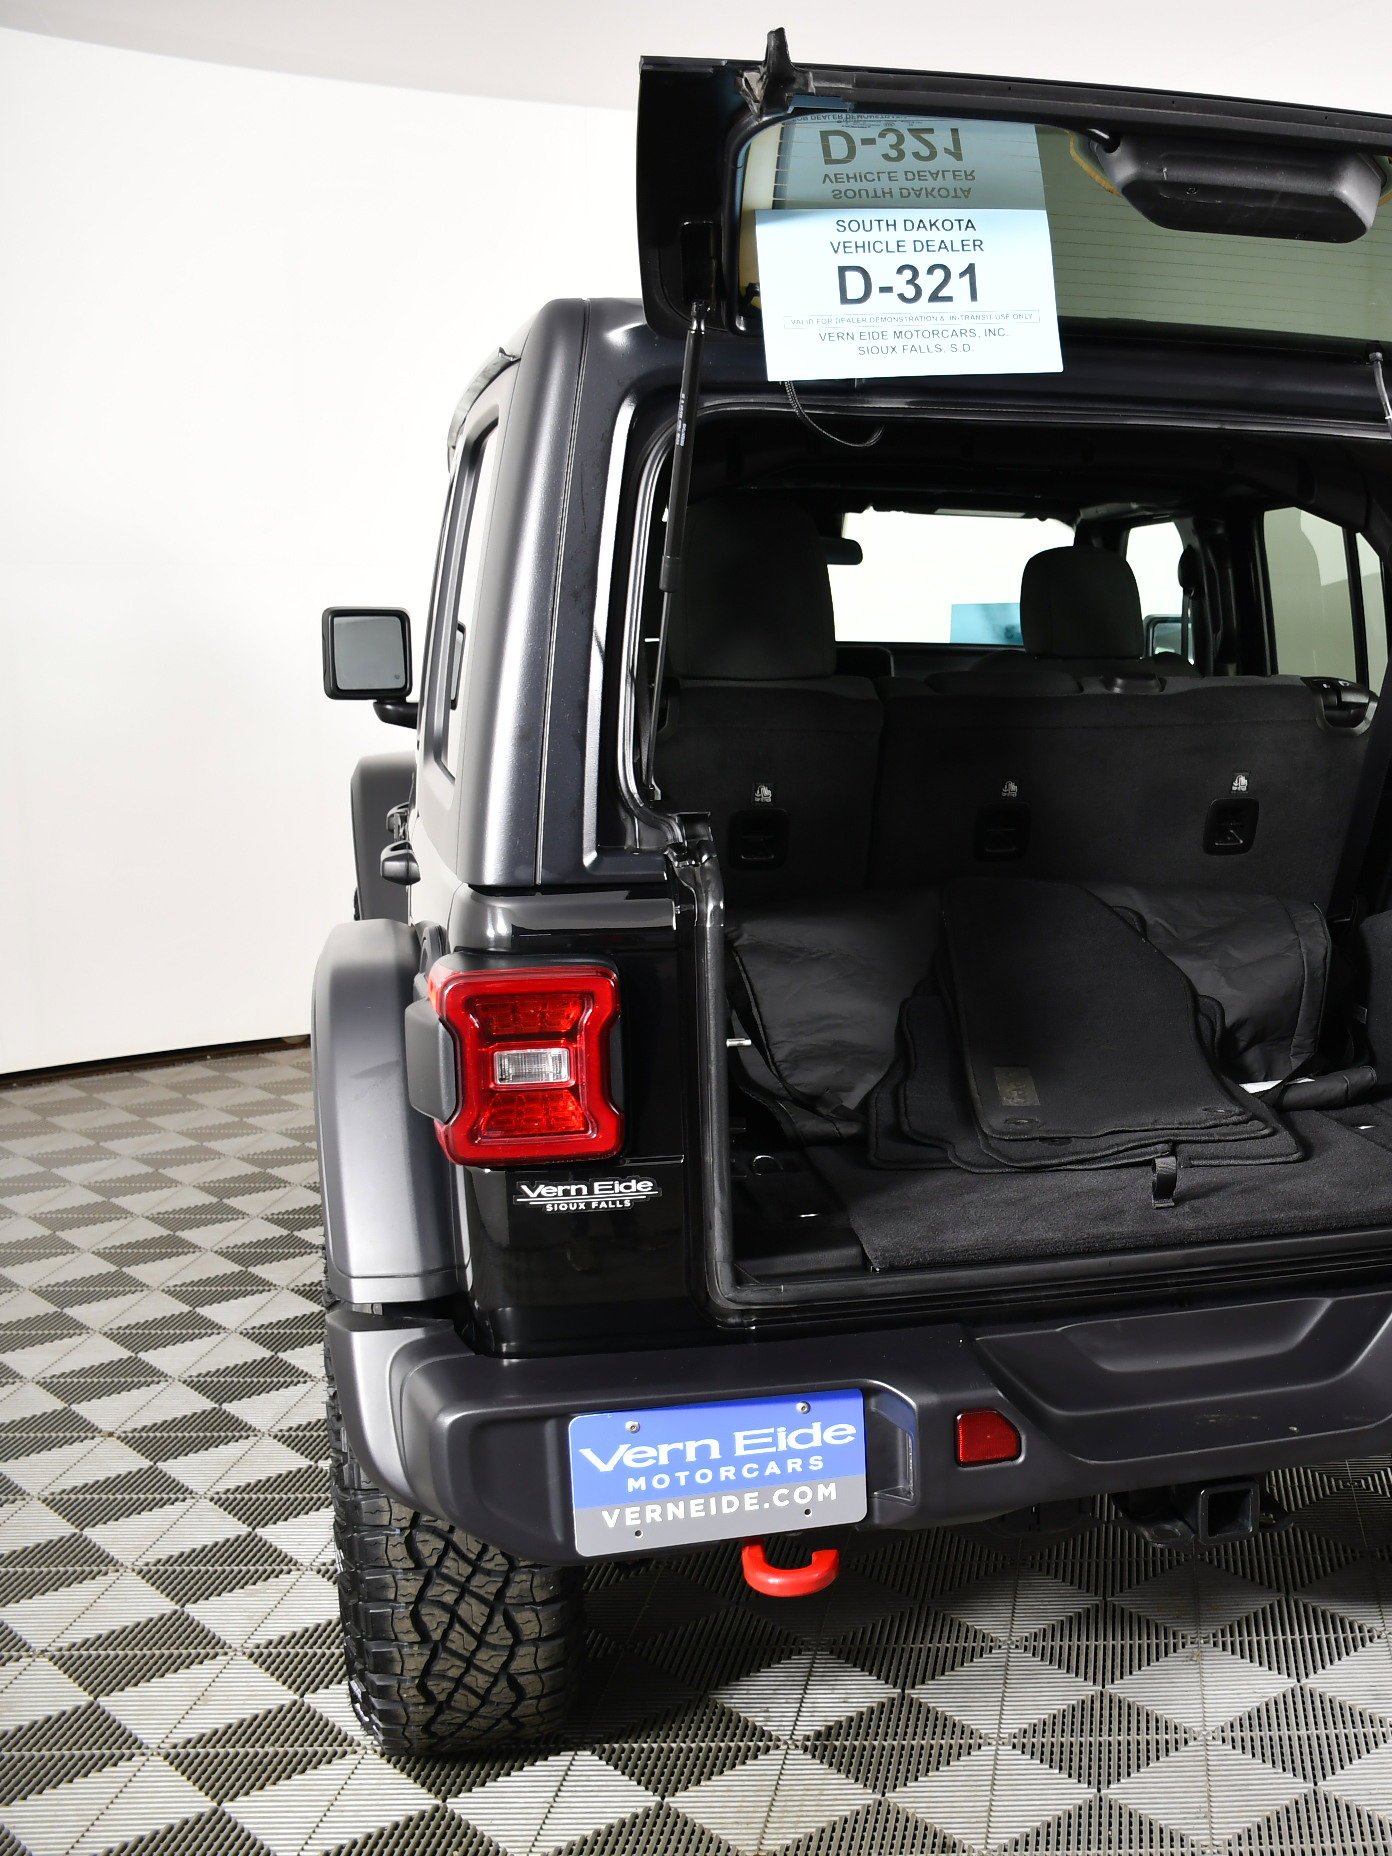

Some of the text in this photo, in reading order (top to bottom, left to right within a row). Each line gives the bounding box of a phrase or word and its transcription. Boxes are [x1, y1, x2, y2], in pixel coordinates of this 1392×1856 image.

[836, 218, 977, 233] SOUTH DAKOTA
[829, 238, 985, 254] VEHICLE DEALER
[837, 262, 978, 305] D-321
[870, 315, 938, 324] DEMONSTRATION
[818, 331, 855, 342] VERN
[859, 330, 889, 341] EIDE
[857, 345, 898, 356] SIOUX
[520, 1179, 654, 1198] Vern Eide
[545, 1199, 631, 1212] SIOUX FALLS
[578, 1420, 857, 1473] Vern Eide
[627, 1455, 824, 1493] MOTORCARS
[601, 1482, 838, 1529] VERNEIDE.COM
